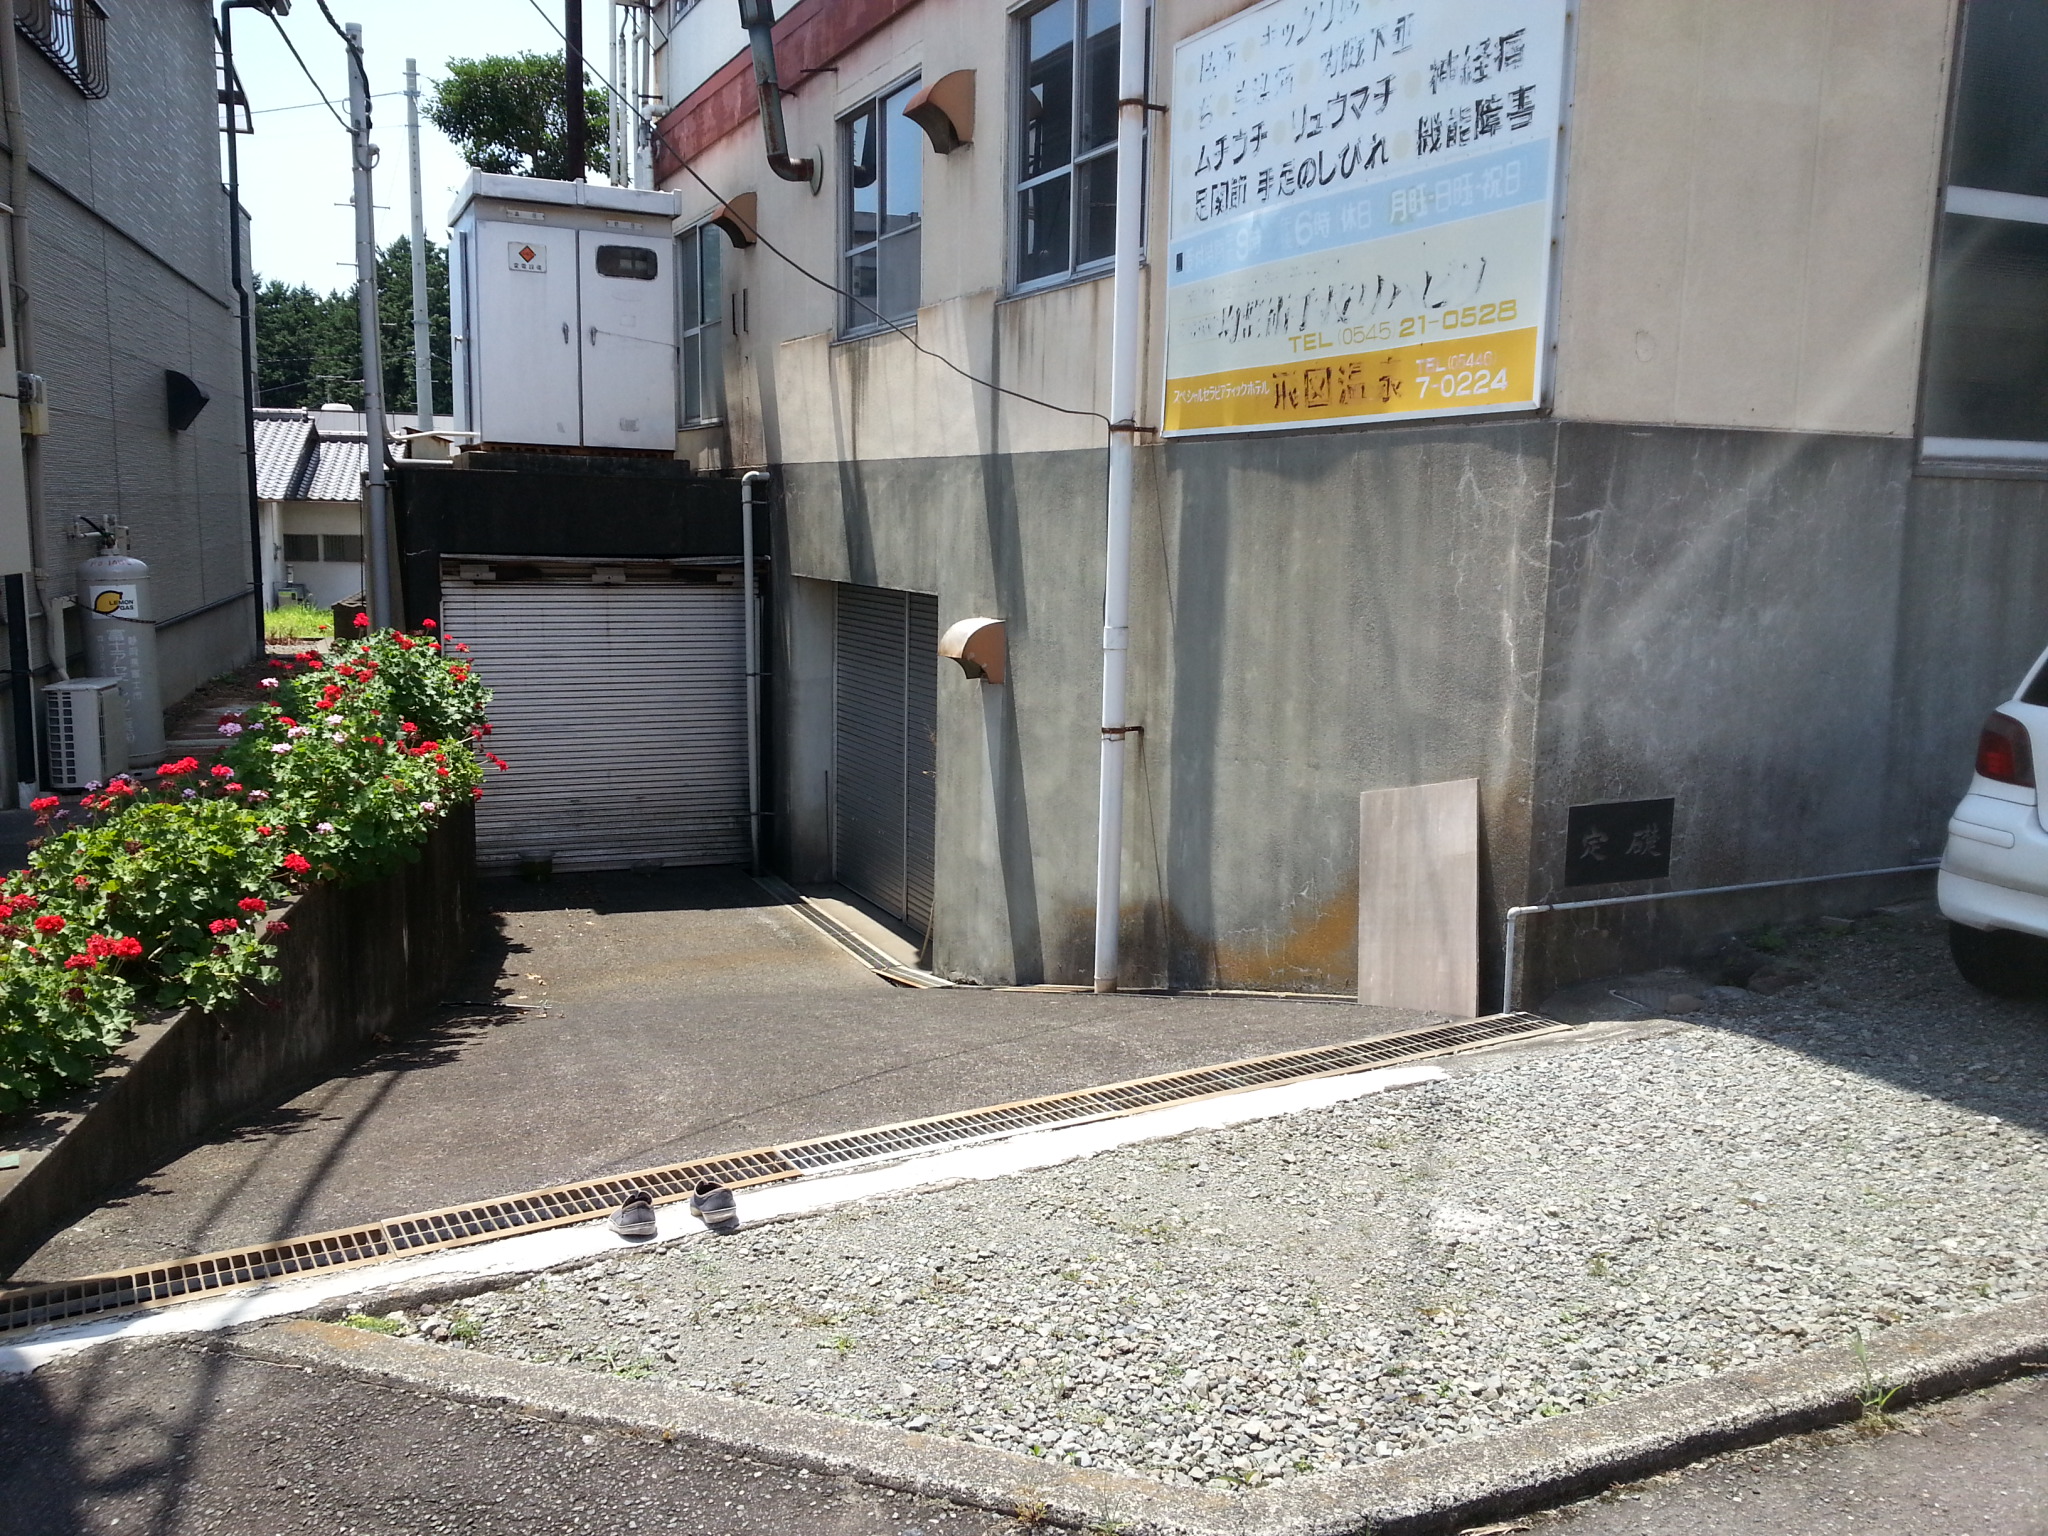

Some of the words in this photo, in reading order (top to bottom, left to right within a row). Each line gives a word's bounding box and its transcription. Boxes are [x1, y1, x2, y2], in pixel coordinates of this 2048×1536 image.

[1194, 120, 1268, 177] ムチウチ
[1292, 73, 1396, 143] リュウマチ
[1257, 132, 1389, 203] 手足のしびれ
[1416, 84, 1536, 157] 機能障害
[1289, 331, 1334, 354] TEL
[1398, 298, 1518, 339] 21-0528
[1415, 367, 1508, 400] 7-0224
